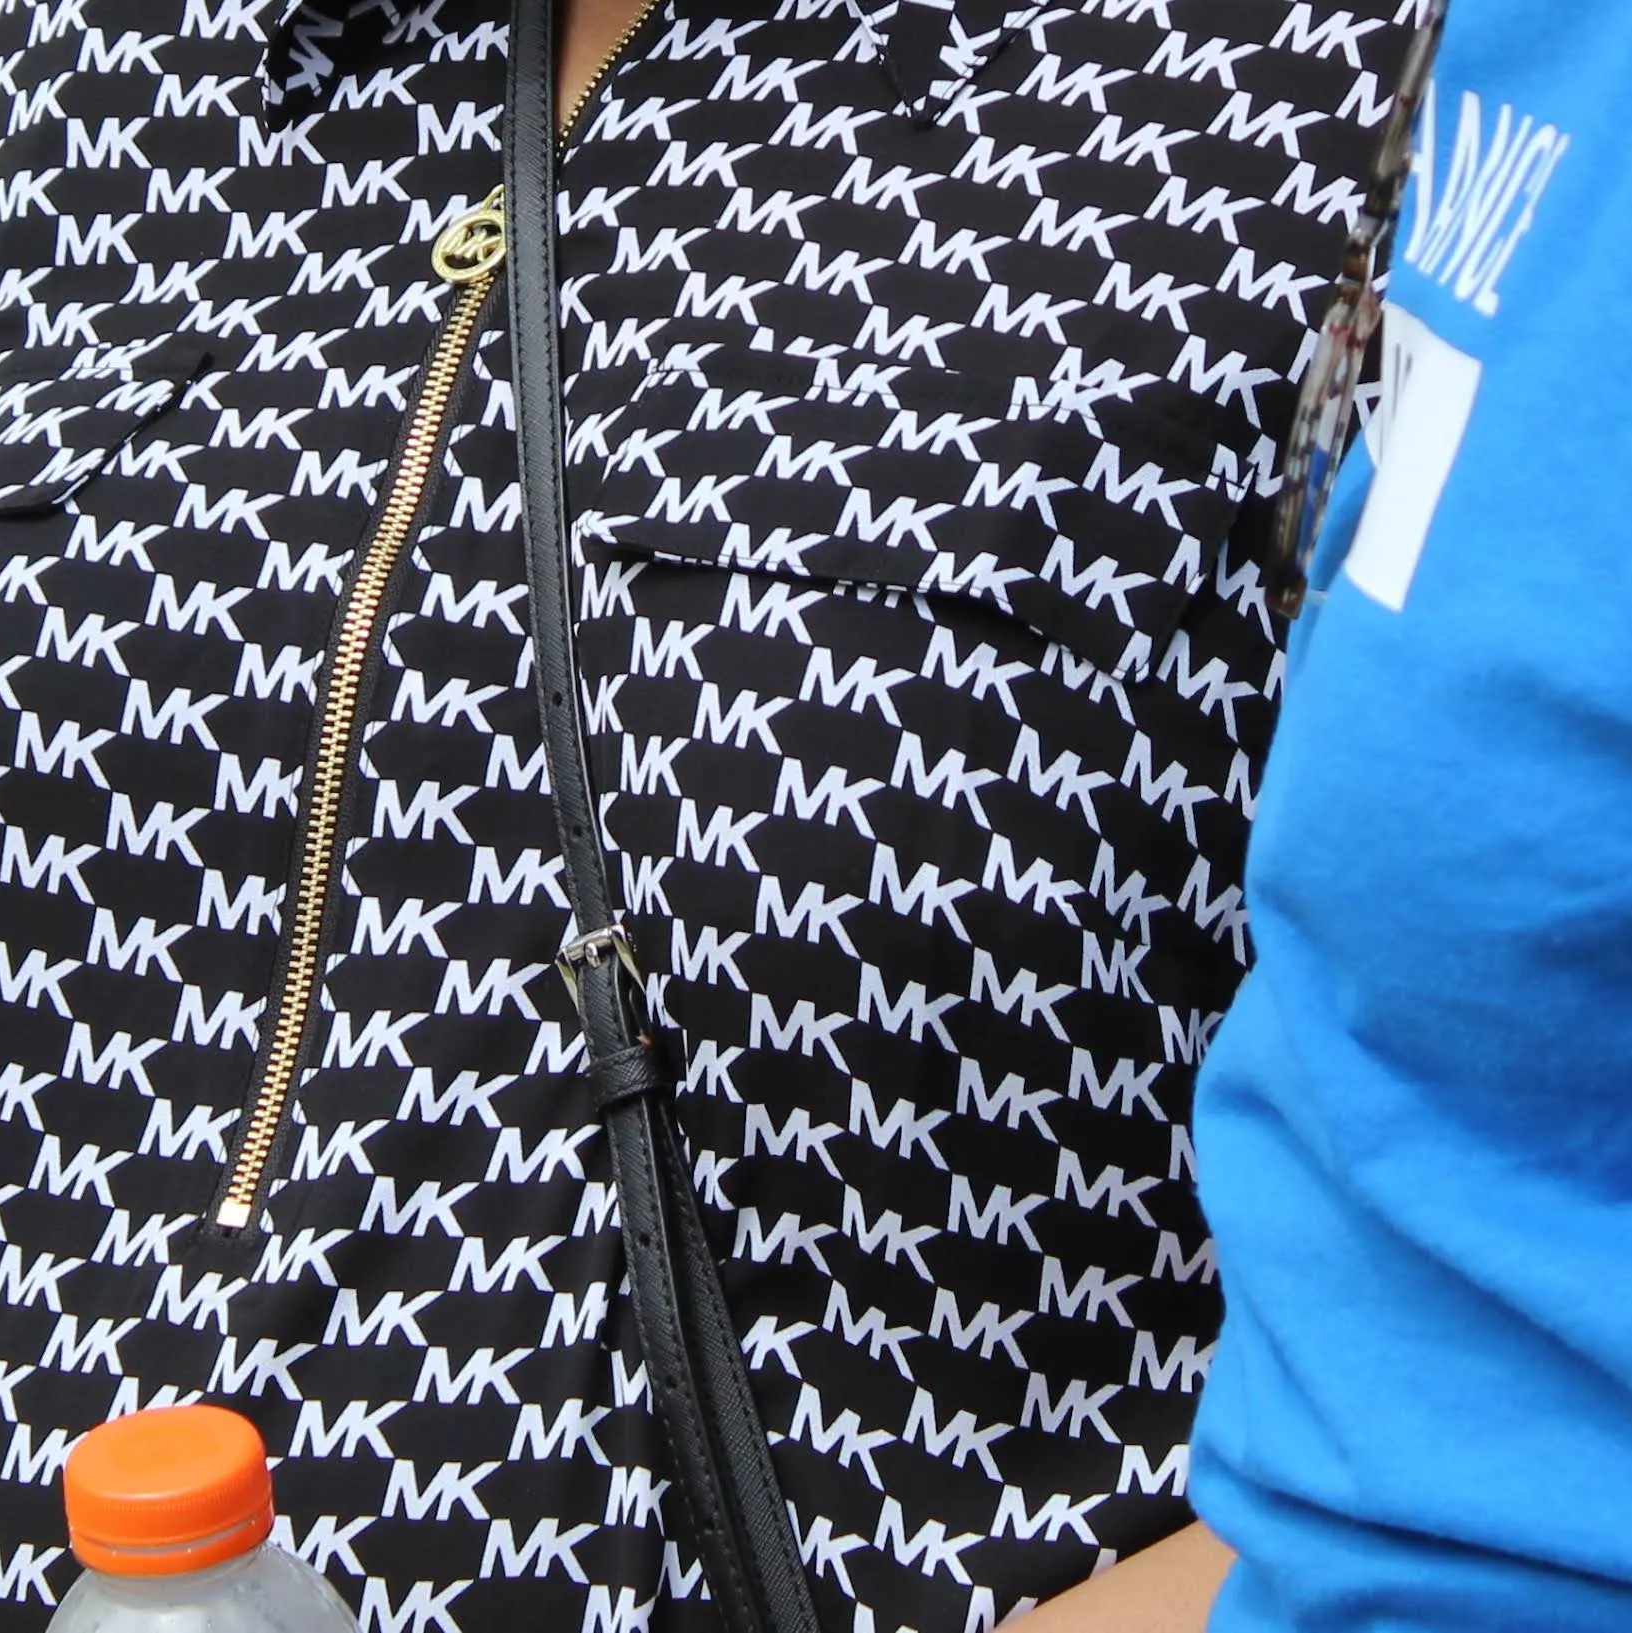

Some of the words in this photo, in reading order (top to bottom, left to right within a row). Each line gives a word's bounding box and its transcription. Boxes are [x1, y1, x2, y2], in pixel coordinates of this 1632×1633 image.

[75, 26, 175, 75] MK
[645, 18, 767, 60] MK
[1142, 30, 1264, 90] MK
[1268, 2, 1387, 70] MK
[153, 74, 251, 118] MK
[329, 63, 425, 112] MK
[707, 54, 827, 103] MK
[1015, 53, 1137, 114] MK
[65, 117, 153, 169] MK
[767, 102, 887, 156] MK
[1076, 114, 1201, 175] MK
[1205, 90, 1331, 160] MK
[145, 166, 237, 214] MK
[321, 156, 415, 209] MK
[645, 140, 763, 188] MK
[831, 156, 947, 219] MK
[950, 135, 1071, 197] MK
[55, 213, 143, 266] MK
[223, 208, 318, 260] MK
[714, 186, 827, 240] MK
[1017, 197, 1139, 260] MK
[1143, 176, 1266, 245] MK
[287, 244, 395, 296] MK
[607, 226, 711, 274] MK
[783, 241, 895, 305] MK
[897, 218, 1013, 283] MK
[673, 271, 779, 326] MK
[970, 283, 1088, 346] MK
[1092, 260, 1211, 333] MK
[1215, 246, 1329, 326] MK
[24, 302, 115, 350] MK
[581, 318, 671, 372] MK
[852, 305, 966, 368] MK
[317, 364, 421, 412] MK
[685, 388, 799, 436] MK
[1167, 334, 1282, 428] MK
[753, 434, 873, 487] MK
[877, 409, 1001, 462] MK
[173, 483, 285, 540] MK
[643, 474, 750, 524] MK
[833, 486, 957, 552] MK
[961, 461, 1078, 531] MK
[1082, 442, 1201, 532] MK
[64, 514, 169, 572] MK
[145, 573, 254, 642] MK
[719, 572, 828, 646] MK
[1039, 534, 1157, 628] MK
[35, 606, 141, 677] MK
[630, 616, 715, 681] MK
[920, 625, 1035, 720] MK
[120, 678, 229, 751] MK
[390, 668, 509, 734] MK
[692, 682, 795, 756] MK
[798, 646, 917, 728] MK
[14, 710, 117, 790] MK
[620, 732, 691, 797] MK
[889, 729, 1003, 831] MK
[1007, 724, 1115, 834] MK
[105, 792, 211, 867] MK
[371, 778, 481, 846] MK
[772, 756, 887, 840] MK
[0, 825, 102, 905] MK
[675, 798, 769, 873] MK
[867, 842, 978, 944] MK
[981, 832, 1085, 926] MK
[86, 906, 193, 983] MK
[350, 896, 463, 958] MK
[755, 874, 865, 960] MK
[671, 918, 751, 992] MK
[434, 958, 551, 1020] MK
[857, 962, 964, 1053] MK
[969, 947, 1077, 1043] MK
[61, 1021, 168, 1097] MK
[321, 1010, 430, 1068] MK
[749, 992, 854, 1075] MK
[396, 1067, 519, 1128] MK
[957, 1056, 1063, 1143] MK
[1068, 1046, 1168, 1122] MK
[290, 1119, 391, 1182] MK
[743, 1104, 844, 1181] MK
[849, 1078, 951, 1170] MK
[27, 1134, 134, 1208] MK
[1054, 1146, 1162, 1227] MK
[91, 1208, 199, 1267] MK
[842, 1184, 941, 1284] MK
[947, 1174, 1049, 1252] MK
[251, 1227, 354, 1286] MK
[145, 1264, 249, 1336] MK
[322, 1288, 444, 1346] MK
[1039, 1256, 1143, 1328] MK
[39, 1313, 142, 1376] MK
[822, 1280, 922, 1382] MK
[928, 1286, 1035, 1369] MK
[206, 1336, 317, 1401] MK
[411, 1346, 535, 1405] MK
[287, 1400, 408, 1459] MK
[507, 1398, 612, 1466] MK
[789, 1382, 897, 1492] MK
[902, 1386, 1015, 1482] MK
[1020, 1372, 1123, 1444] MK
[381, 1458, 502, 1521] MK
[990, 1484, 1111, 1546] MK
[479, 1518, 600, 1584] MK
[873, 1495, 986, 1585] MK
